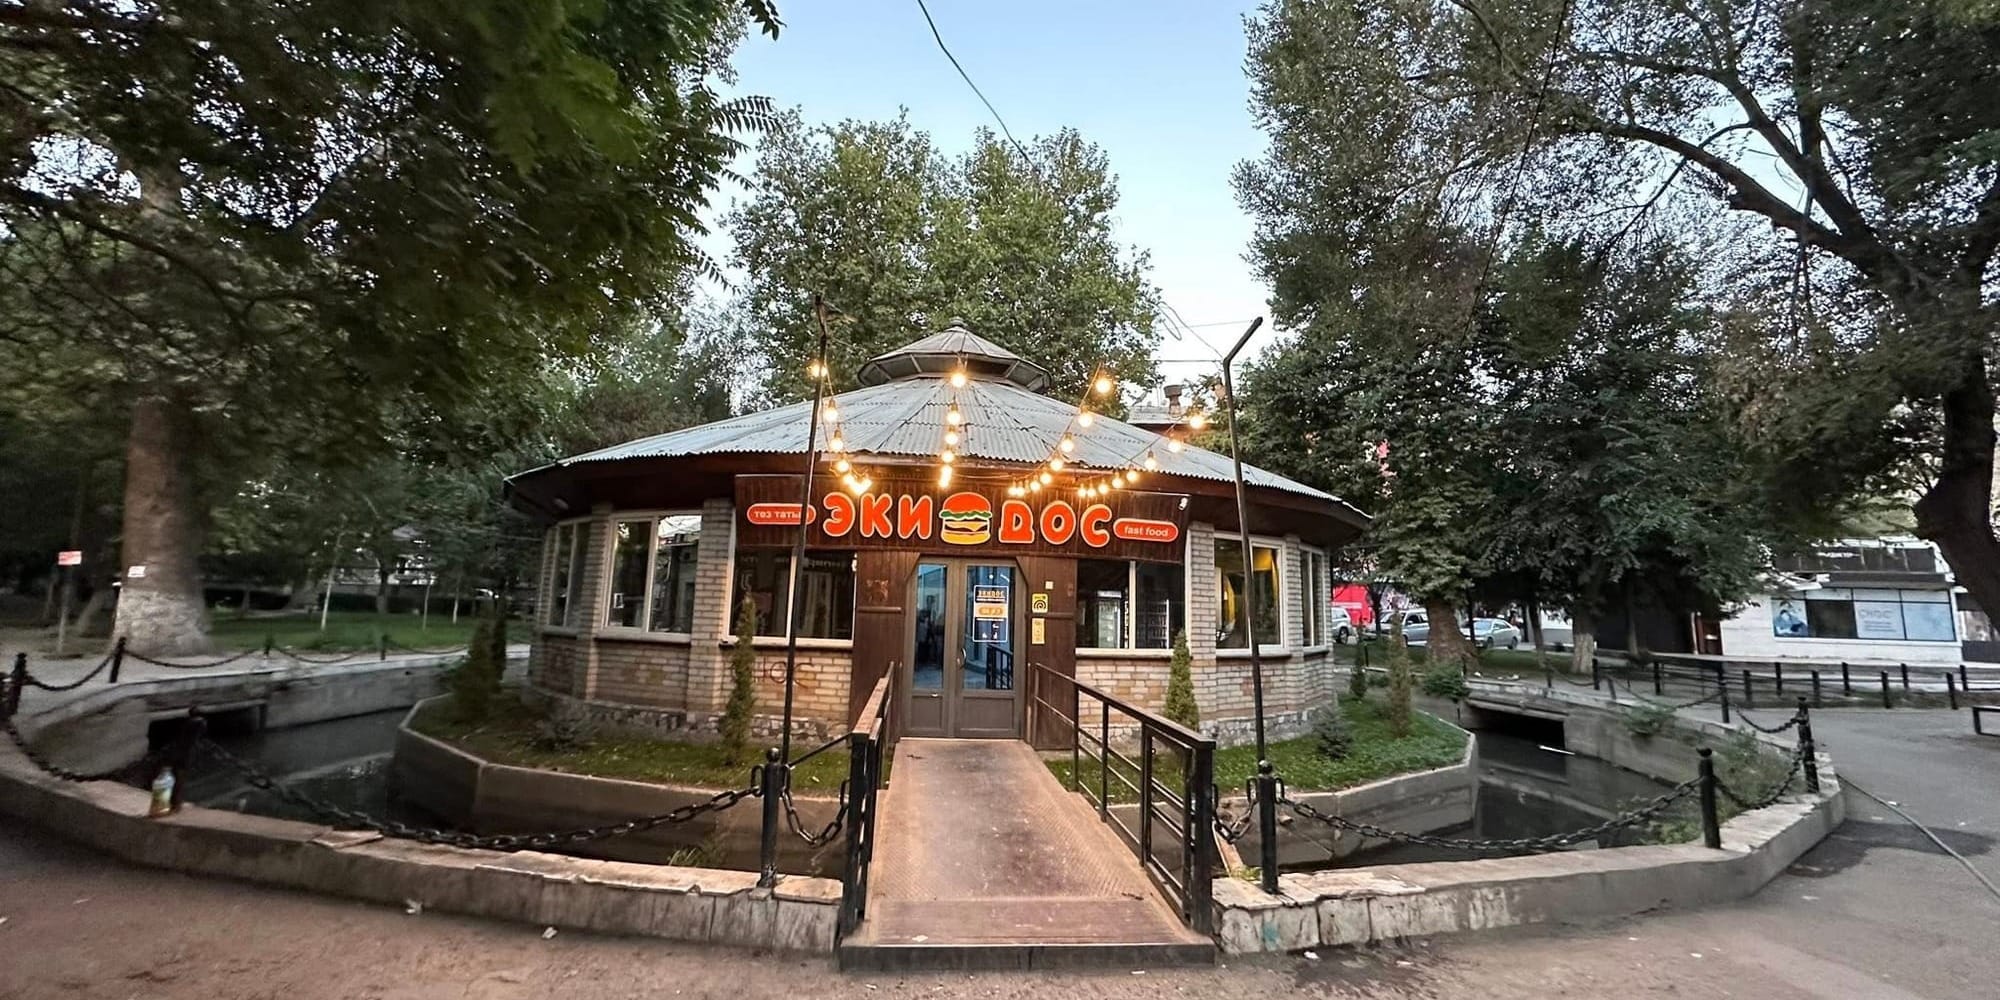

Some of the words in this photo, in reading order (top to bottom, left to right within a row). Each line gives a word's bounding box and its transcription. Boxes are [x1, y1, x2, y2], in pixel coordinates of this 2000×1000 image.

[823, 492, 932, 540] ЭКИ
[998, 500, 1112, 548] ДОС
[1124, 525, 1143, 535] fast
[1145, 526, 1169, 537] food
